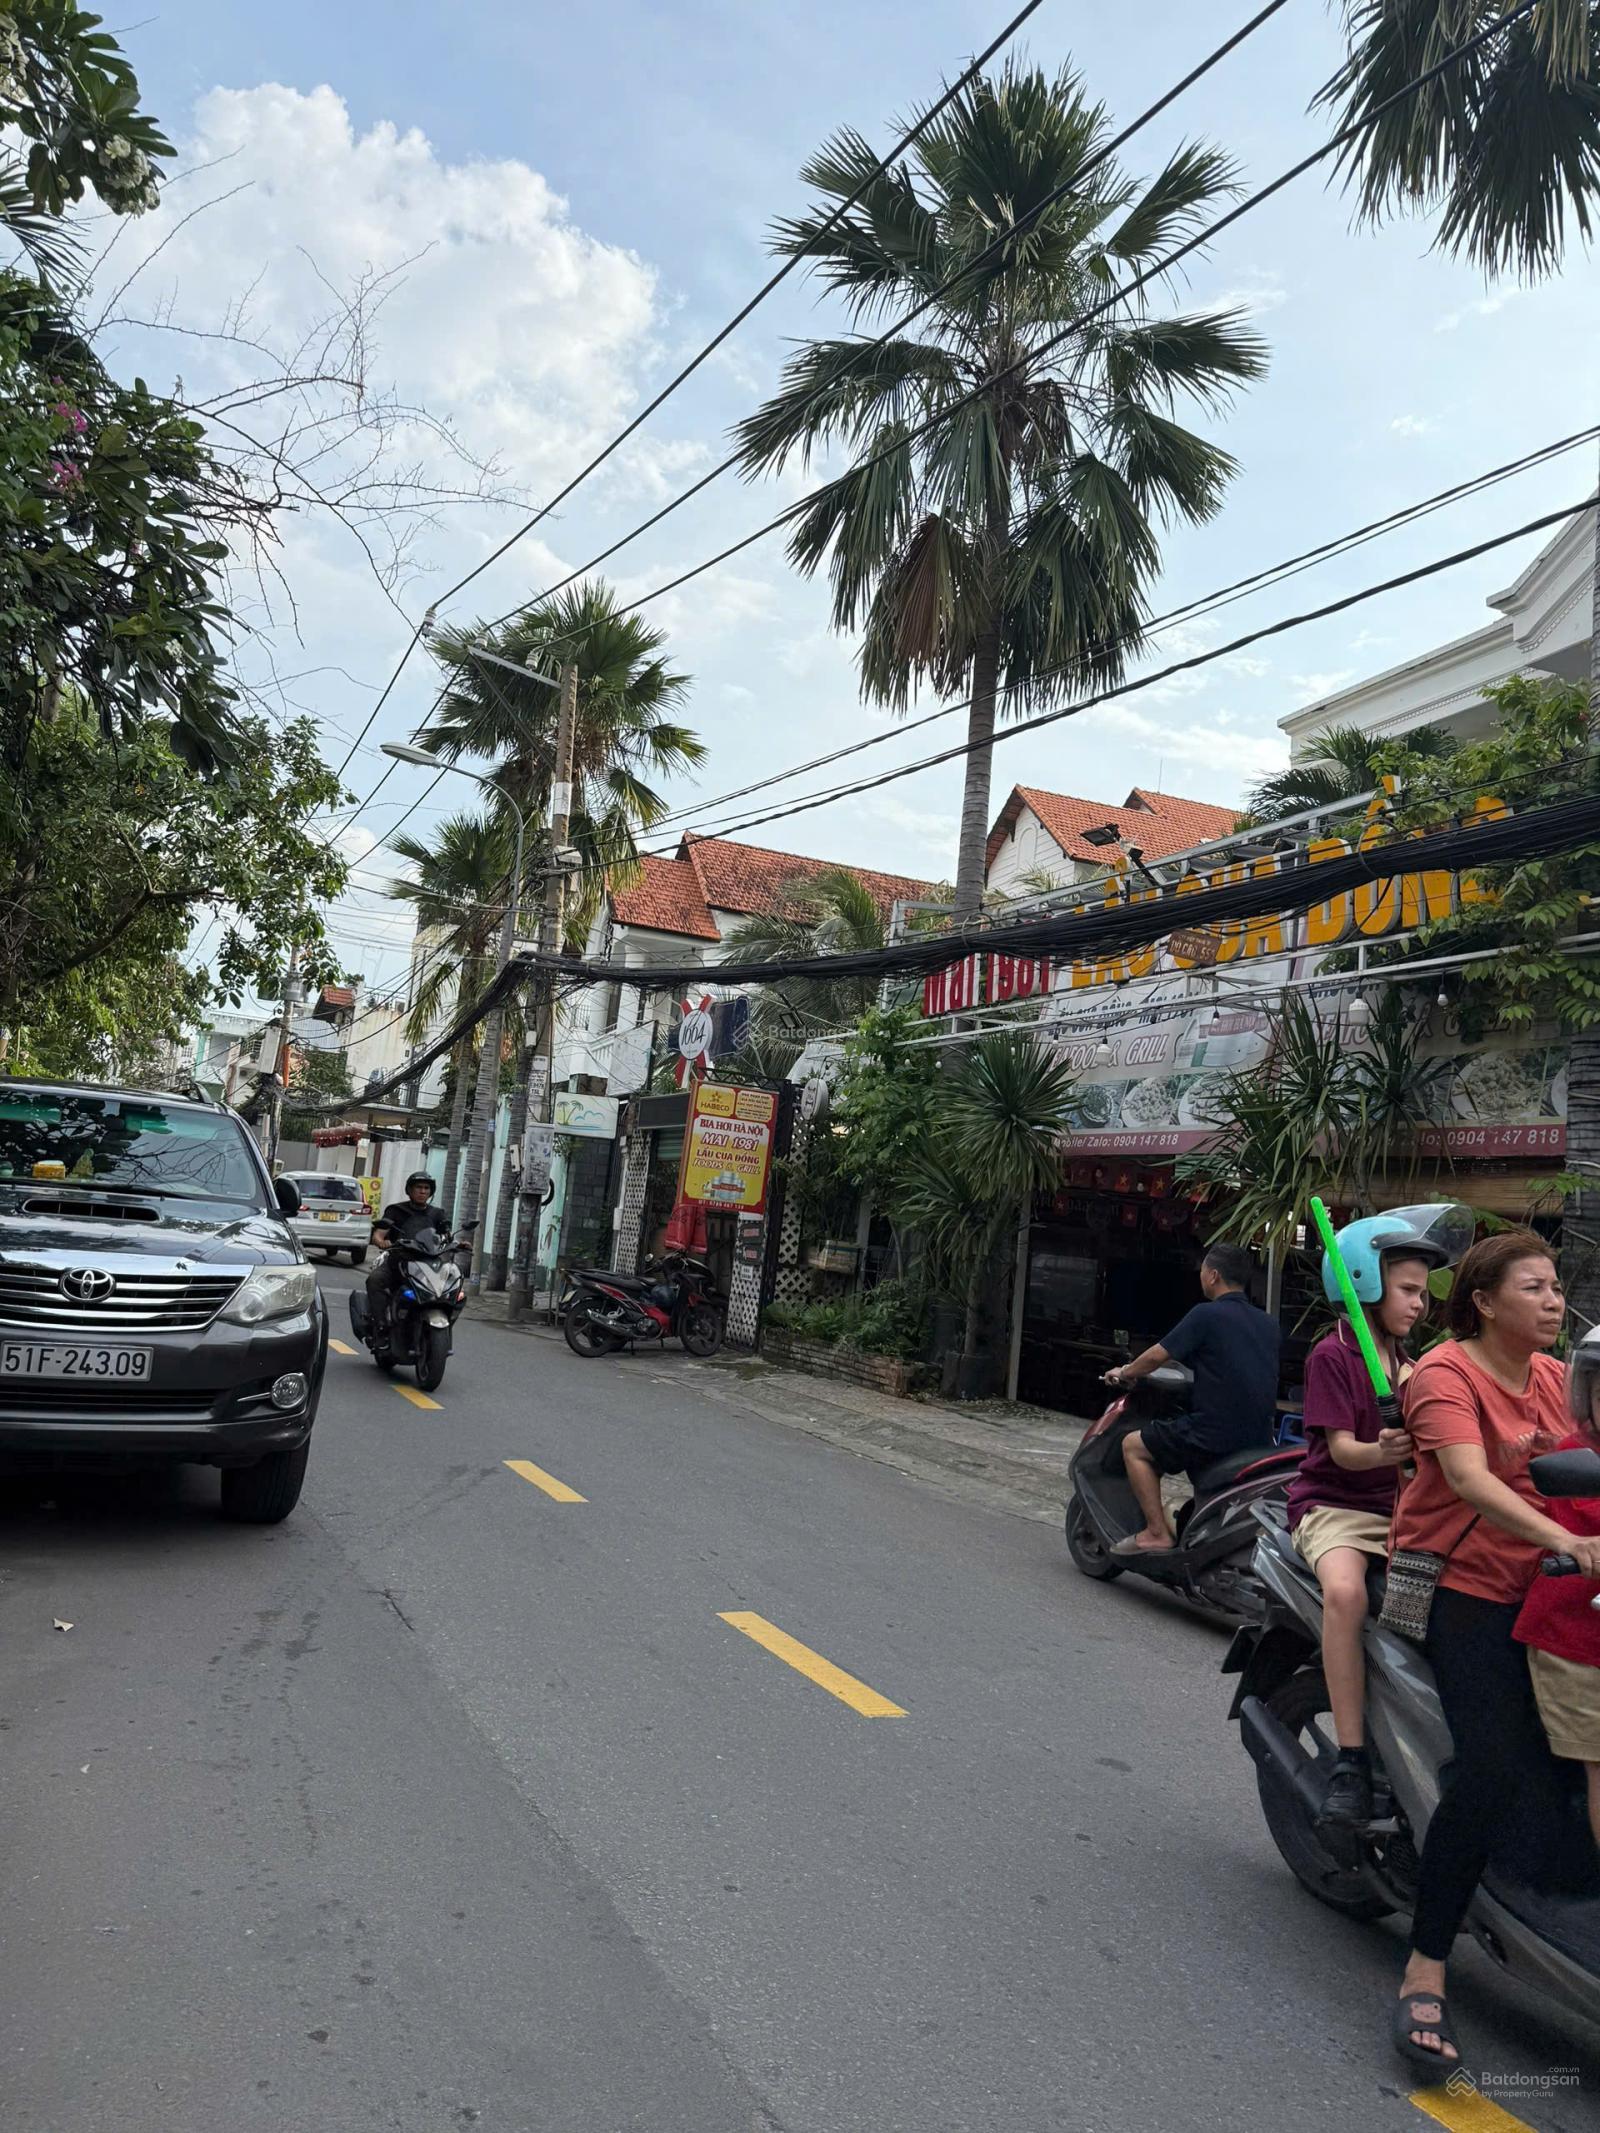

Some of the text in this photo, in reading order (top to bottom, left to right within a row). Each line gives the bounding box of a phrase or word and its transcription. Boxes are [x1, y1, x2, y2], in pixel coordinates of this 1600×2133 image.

[1125, 1033, 1170, 1067] GRILL
[700, 1102, 729, 1112] HABECO
[700, 1118, 714, 1128] BIA
[701, 1132, 760, 1152] MAI 1981
[1087, 1135, 1112, 1148] Zalo:
[1113, 1135, 1137, 1147] 0904
[1139, 1134, 1159, 1146] 147
[1159, 1133, 1180, 1146] 818
[1447, 1131, 1486, 1146] 0904
[1527, 1128, 1560, 1144] 818
[715, 1151, 733, 1161] CUA
[5, 1346, 147, 1377] 51F-243.09
